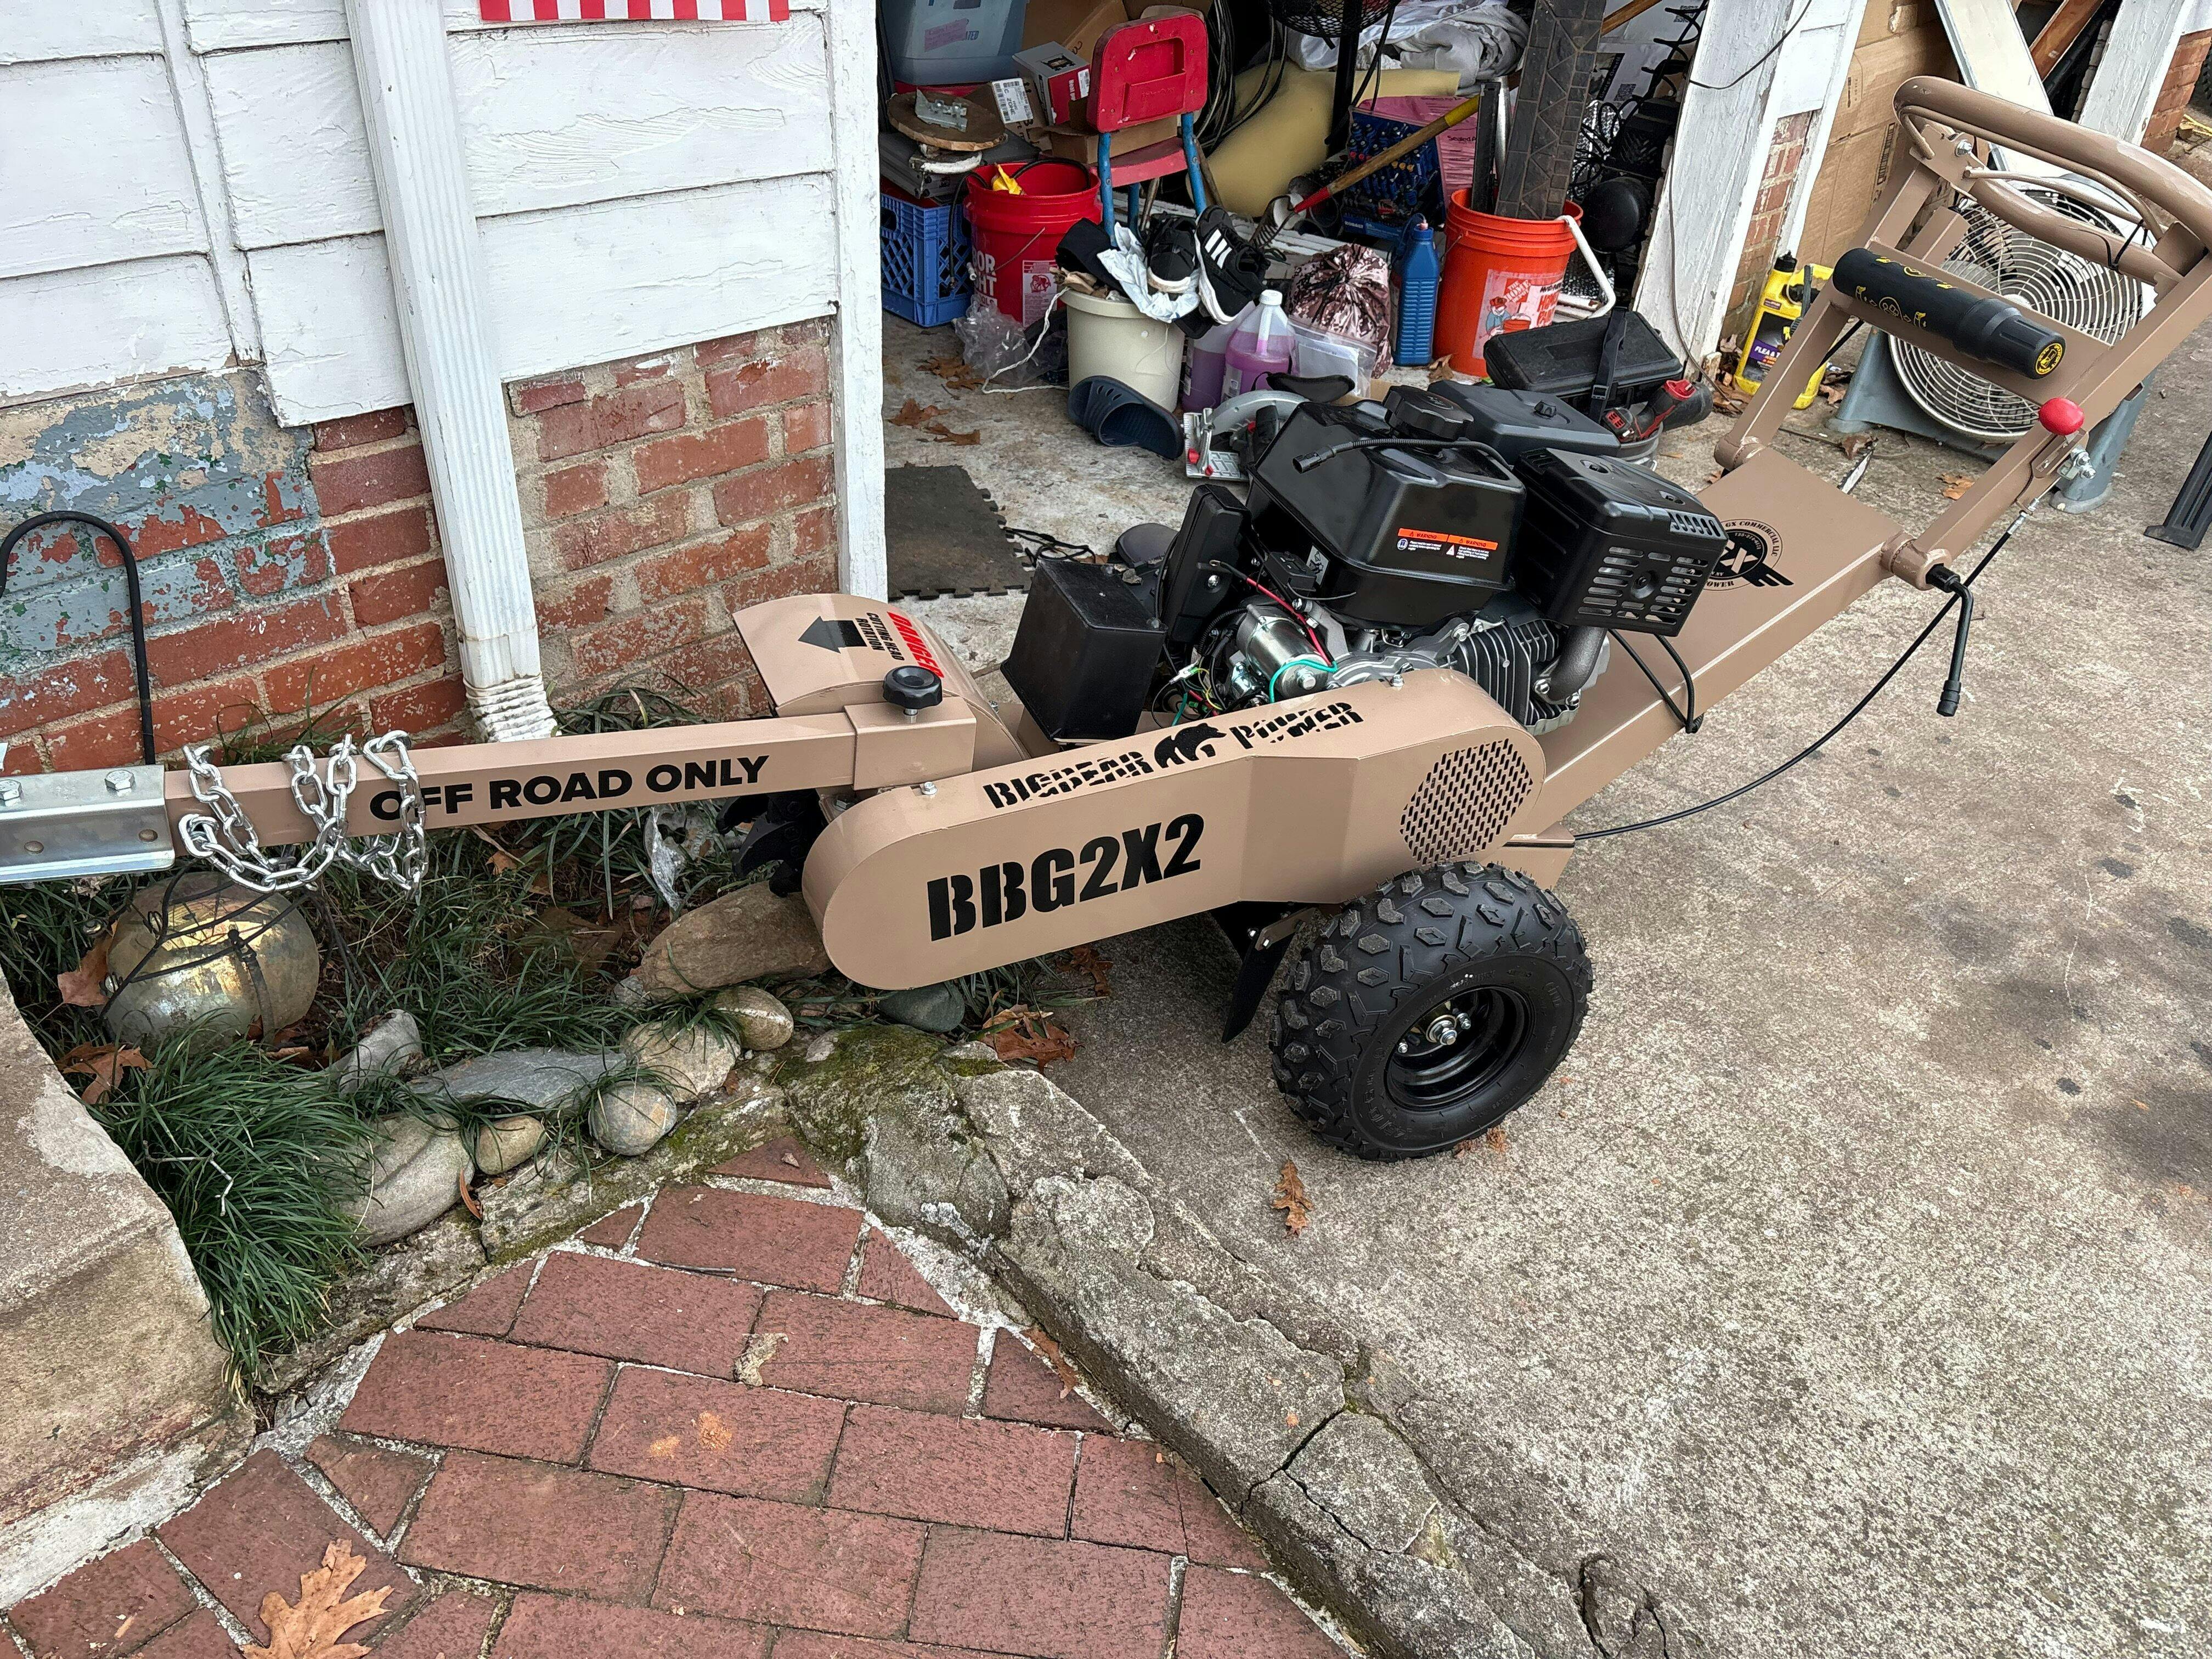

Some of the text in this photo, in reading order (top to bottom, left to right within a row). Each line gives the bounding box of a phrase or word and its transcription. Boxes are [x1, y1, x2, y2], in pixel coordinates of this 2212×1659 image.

[1754, 346, 1770, 356] FLEA
[1739, 521, 1780, 545] COMMERCIAL
[1770, 545, 1780, 557] LLC
[855, 618, 885, 651] ROTATION
[866, 612, 905, 661] CUTTING HEAD
[887, 611, 945, 678] DANGER
[983, 702, 1364, 809] BIGBEAR POWER
[369, 755, 770, 821] OFF ROAD ONLY
[927, 813, 1205, 942] BBG2X2
